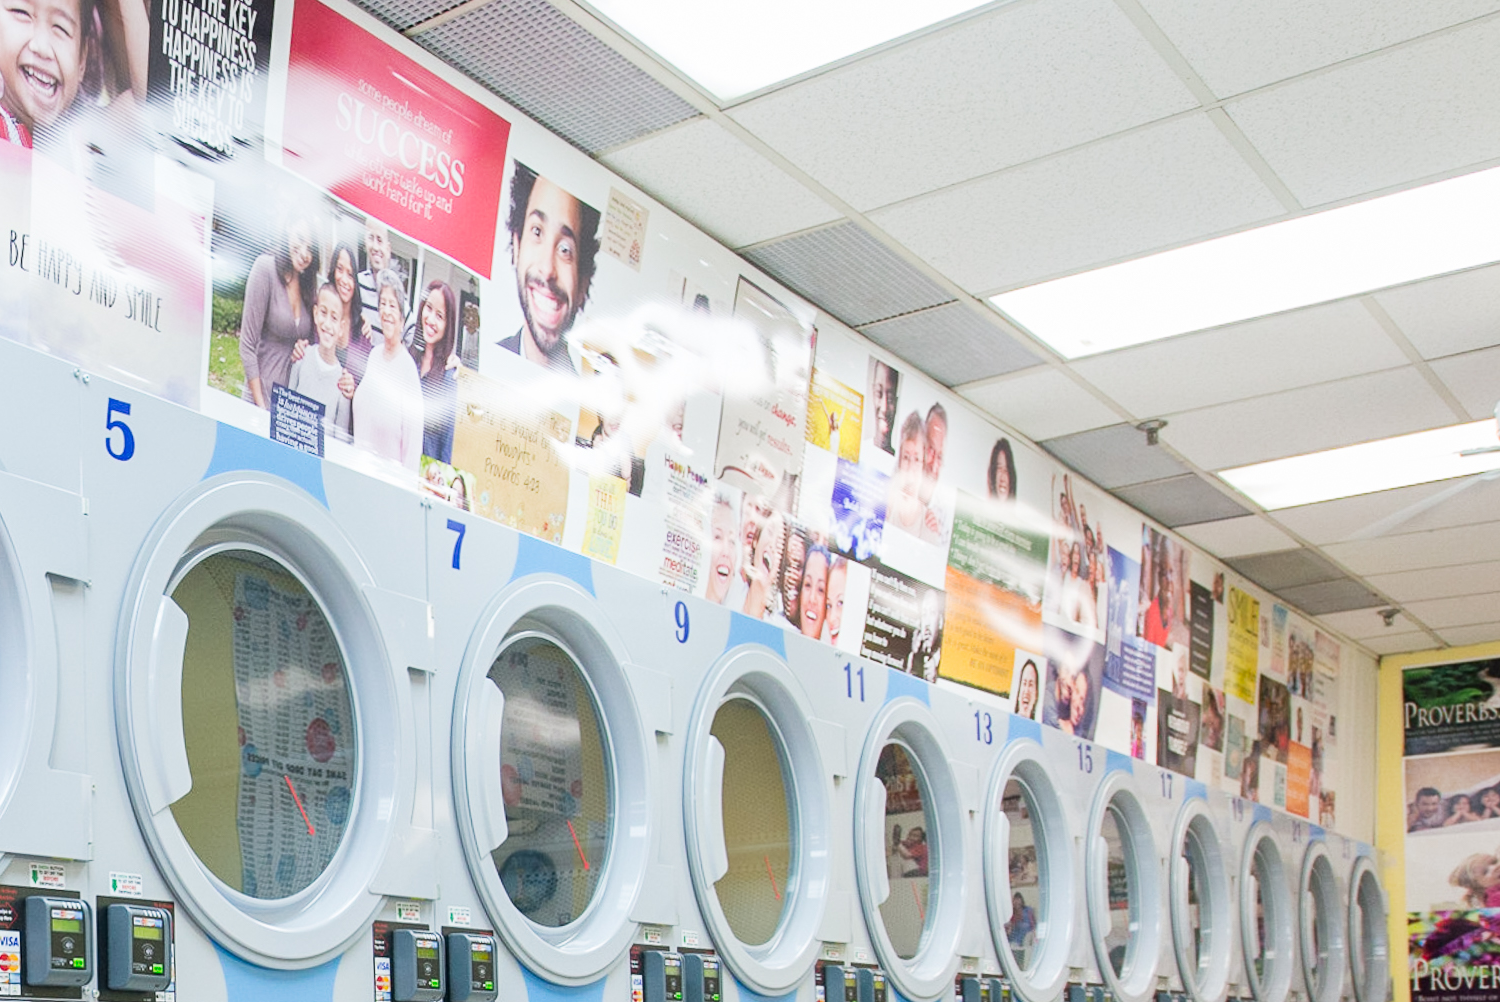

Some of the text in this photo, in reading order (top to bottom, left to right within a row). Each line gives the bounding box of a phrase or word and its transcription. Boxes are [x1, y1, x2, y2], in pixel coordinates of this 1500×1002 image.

[181, 0, 259, 76] HAPPINESS.
[229, 0, 257, 39] KEY
[162, 21, 254, 104] HAPPINESS IS
[169, 58, 244, 131] THE KEY TO
[358, 79, 454, 145] some people dream of
[173, 96, 236, 158] SUCCESS.
[335, 92, 465, 197] SUCCESS
[362, 172, 385, 195] work
[385, 184, 408, 208] hard
[408, 196, 424, 215] for
[400, 176, 423, 198] wake
[424, 190, 436, 206] up
[435, 195, 453, 213] and
[9, 229, 163, 333] BE HAPPY AND SMILE
[105, 397, 136, 462] 5
[484, 457, 520, 486] Proverbs
[665, 453, 686, 478] Happy
[446, 519, 466, 570] 7
[667, 531, 701, 554] exercise
[664, 557, 698, 580] meditate
[674, 601, 690, 644] 9
[844, 663, 864, 702] 11
[974, 710, 993, 745] 13
[1405, 701, 1498, 729] PROVERBS
[1077, 741, 1094, 774] 15
[1160, 771, 1172, 799] 17
[0, 936, 19, 947] VISA
